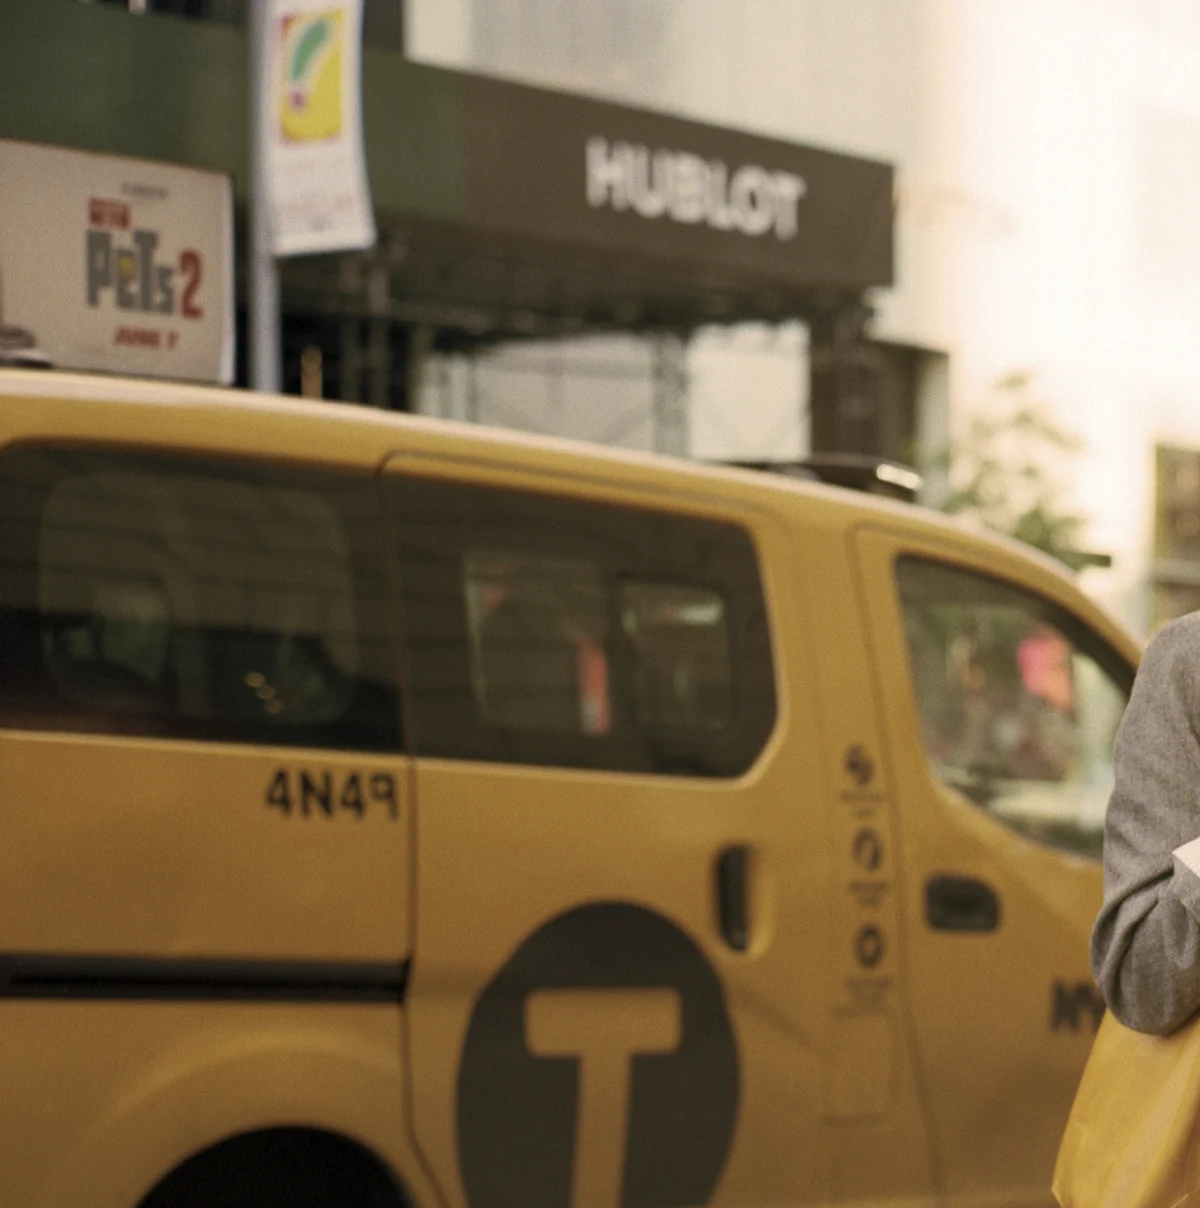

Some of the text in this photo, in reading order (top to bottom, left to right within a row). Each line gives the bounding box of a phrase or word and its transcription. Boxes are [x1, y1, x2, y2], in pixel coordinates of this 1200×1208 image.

[585, 134, 805, 241] HUBLOT
[178, 249, 204, 320] 2
[266, 769, 399, 820] 4N49
